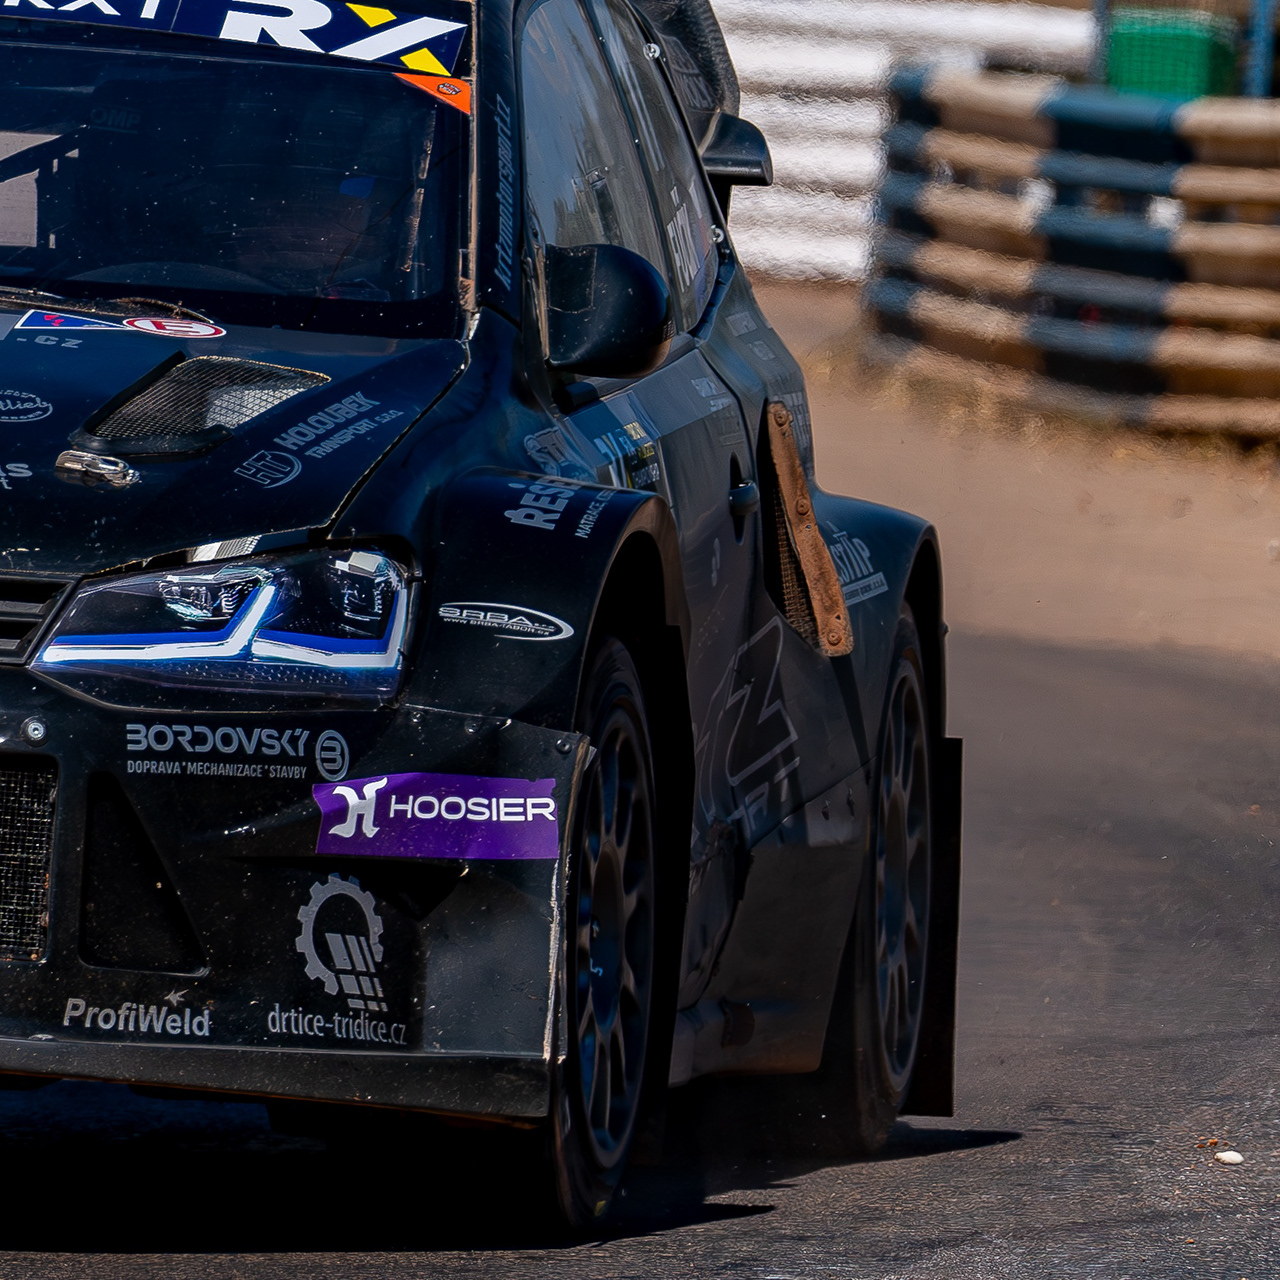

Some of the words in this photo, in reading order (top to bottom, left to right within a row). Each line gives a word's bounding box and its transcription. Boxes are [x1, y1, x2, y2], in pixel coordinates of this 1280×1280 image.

[273, 391, 381, 450] HOLOUBEK
[304, 419, 378, 459] TRANSPORT
[389, 795, 556, 821] HOOSIER
[62, 998, 210, 1037] ProfiWeld
[268, 1002, 407, 1046] drtice-tridice.cz
